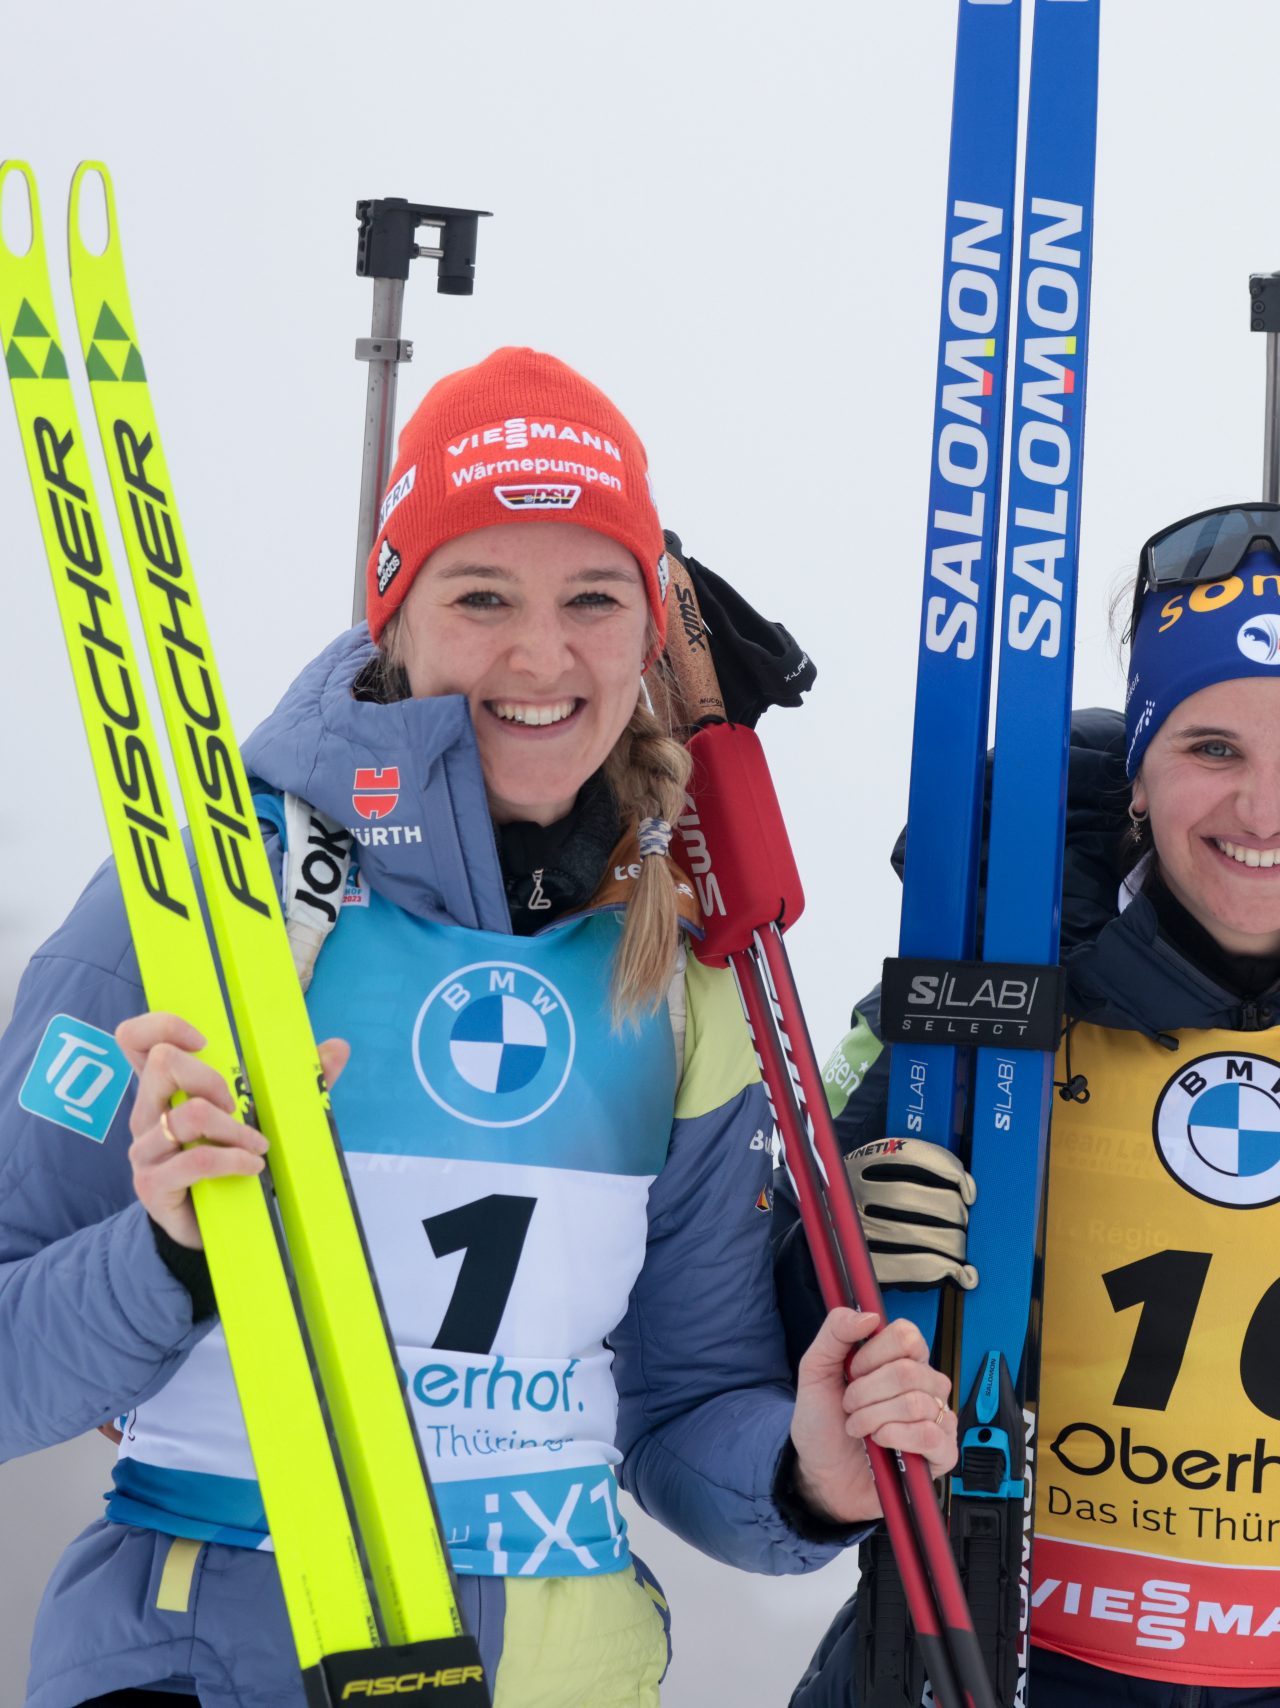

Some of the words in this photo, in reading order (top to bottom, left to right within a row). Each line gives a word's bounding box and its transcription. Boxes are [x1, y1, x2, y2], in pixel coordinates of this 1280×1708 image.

[447, 418, 622, 462] VIESSMANN
[925, 199, 1004, 661] SALOMON
[1007, 196, 1084, 659] SALOMON
[451, 457, 622, 491] Wärmepumpen
[379, 555, 400, 588] adidas
[33, 415, 191, 921] FISCHER
[112, 417, 273, 919] FISCHER
[440, 969, 558, 1016] BMW
[902, 1019, 1028, 1037] SELECT
[421, 1193, 538, 1356] 1
[985, 1358, 997, 1397] SALOMON
[1048, 1486, 1117, 1525] Das
[1131, 1501, 1176, 1535] ist
[341, 1665, 484, 1700] FISCHER
